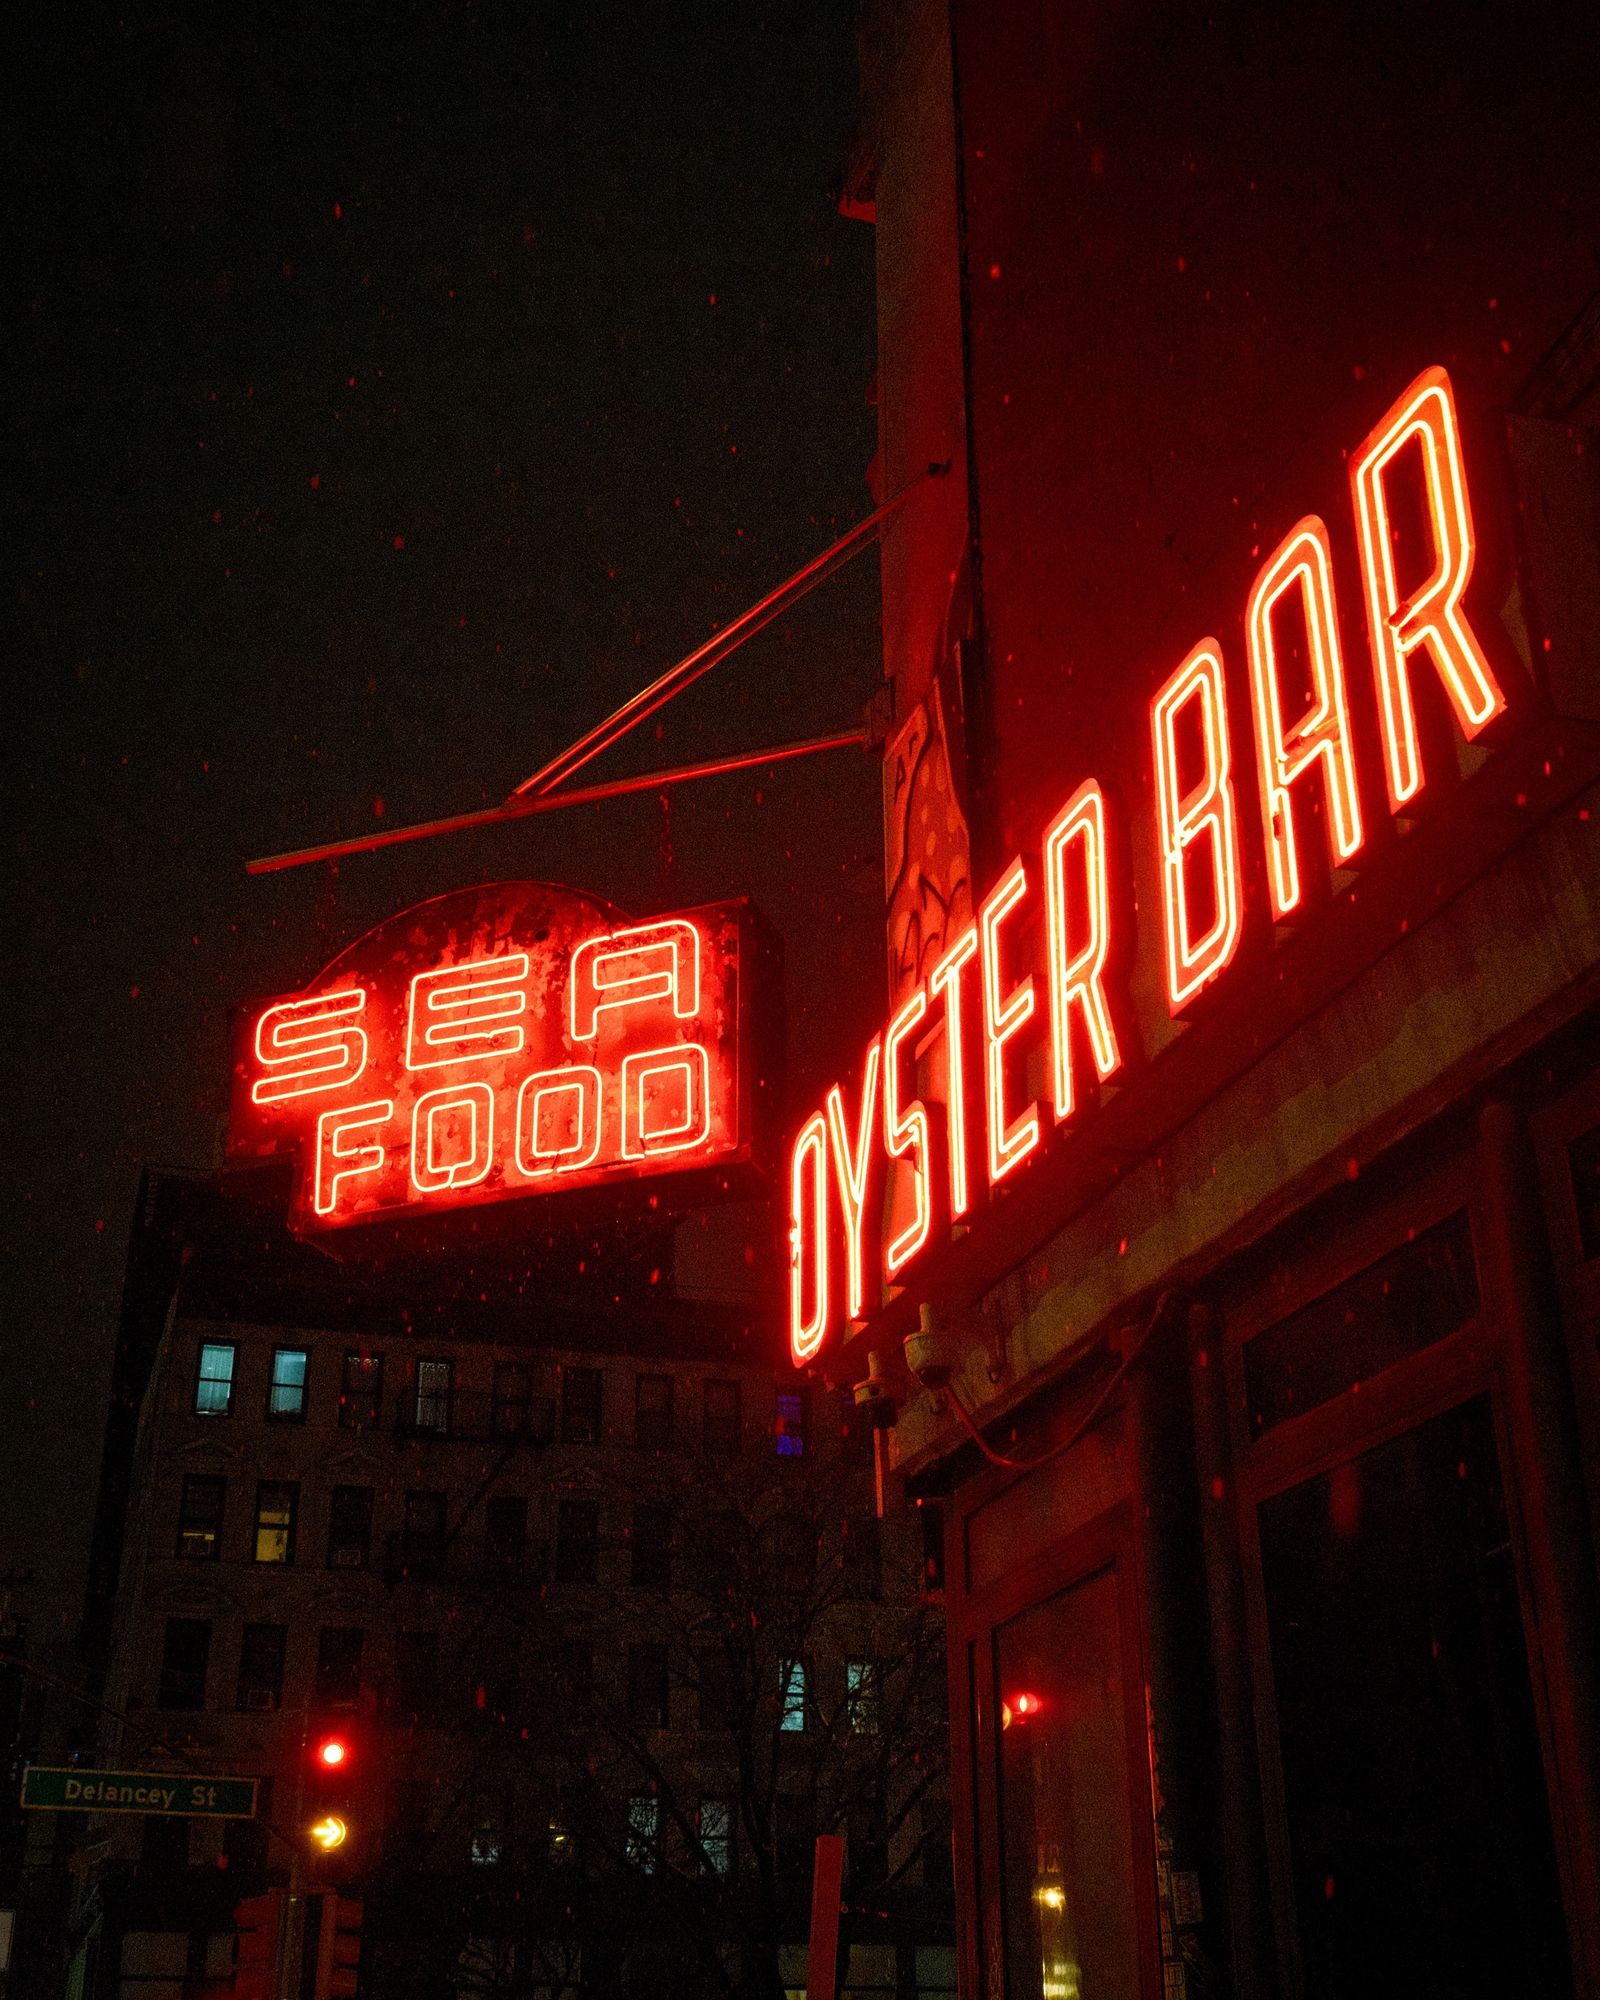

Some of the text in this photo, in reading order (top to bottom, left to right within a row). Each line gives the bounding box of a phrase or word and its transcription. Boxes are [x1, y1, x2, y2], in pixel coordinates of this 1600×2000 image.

[789, 365, 1508, 1368] OYSTER BAR
[250, 918, 701, 1106] SEA
[313, 1042, 711, 1215] FOOD
[63, 1778, 218, 1810] Delancey St
